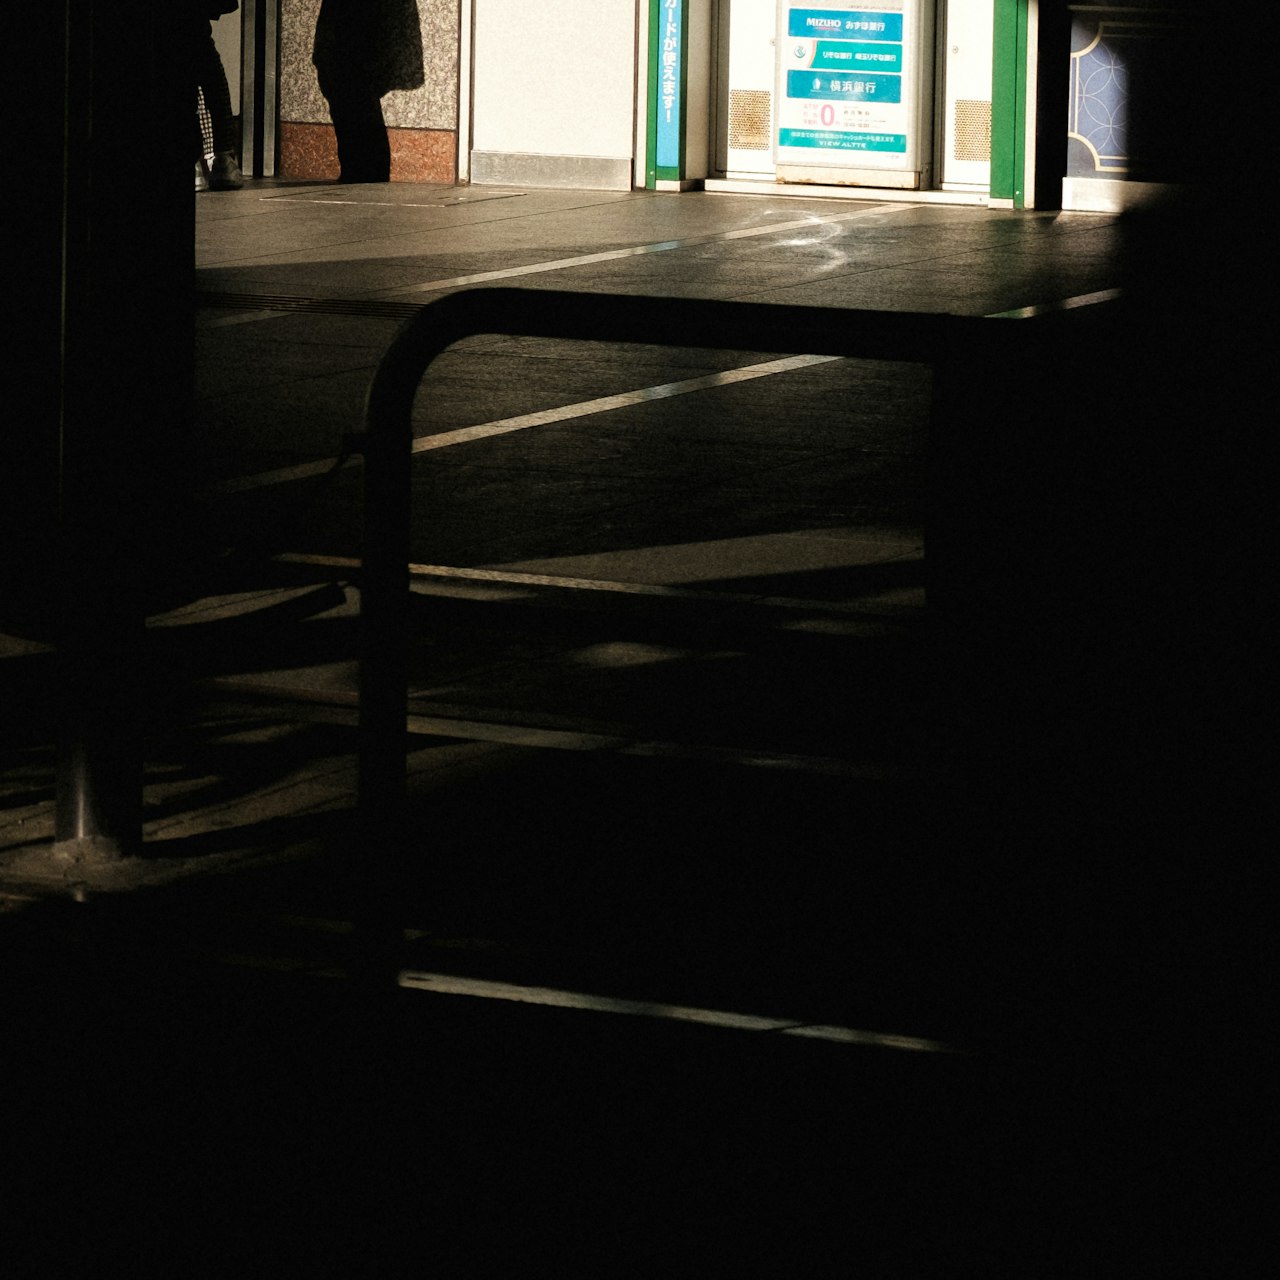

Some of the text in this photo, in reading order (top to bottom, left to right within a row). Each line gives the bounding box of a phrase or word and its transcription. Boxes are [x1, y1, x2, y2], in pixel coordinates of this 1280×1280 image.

[830, 80, 877, 94] 横浜銀行
[820, 103, 835, 127] 0
